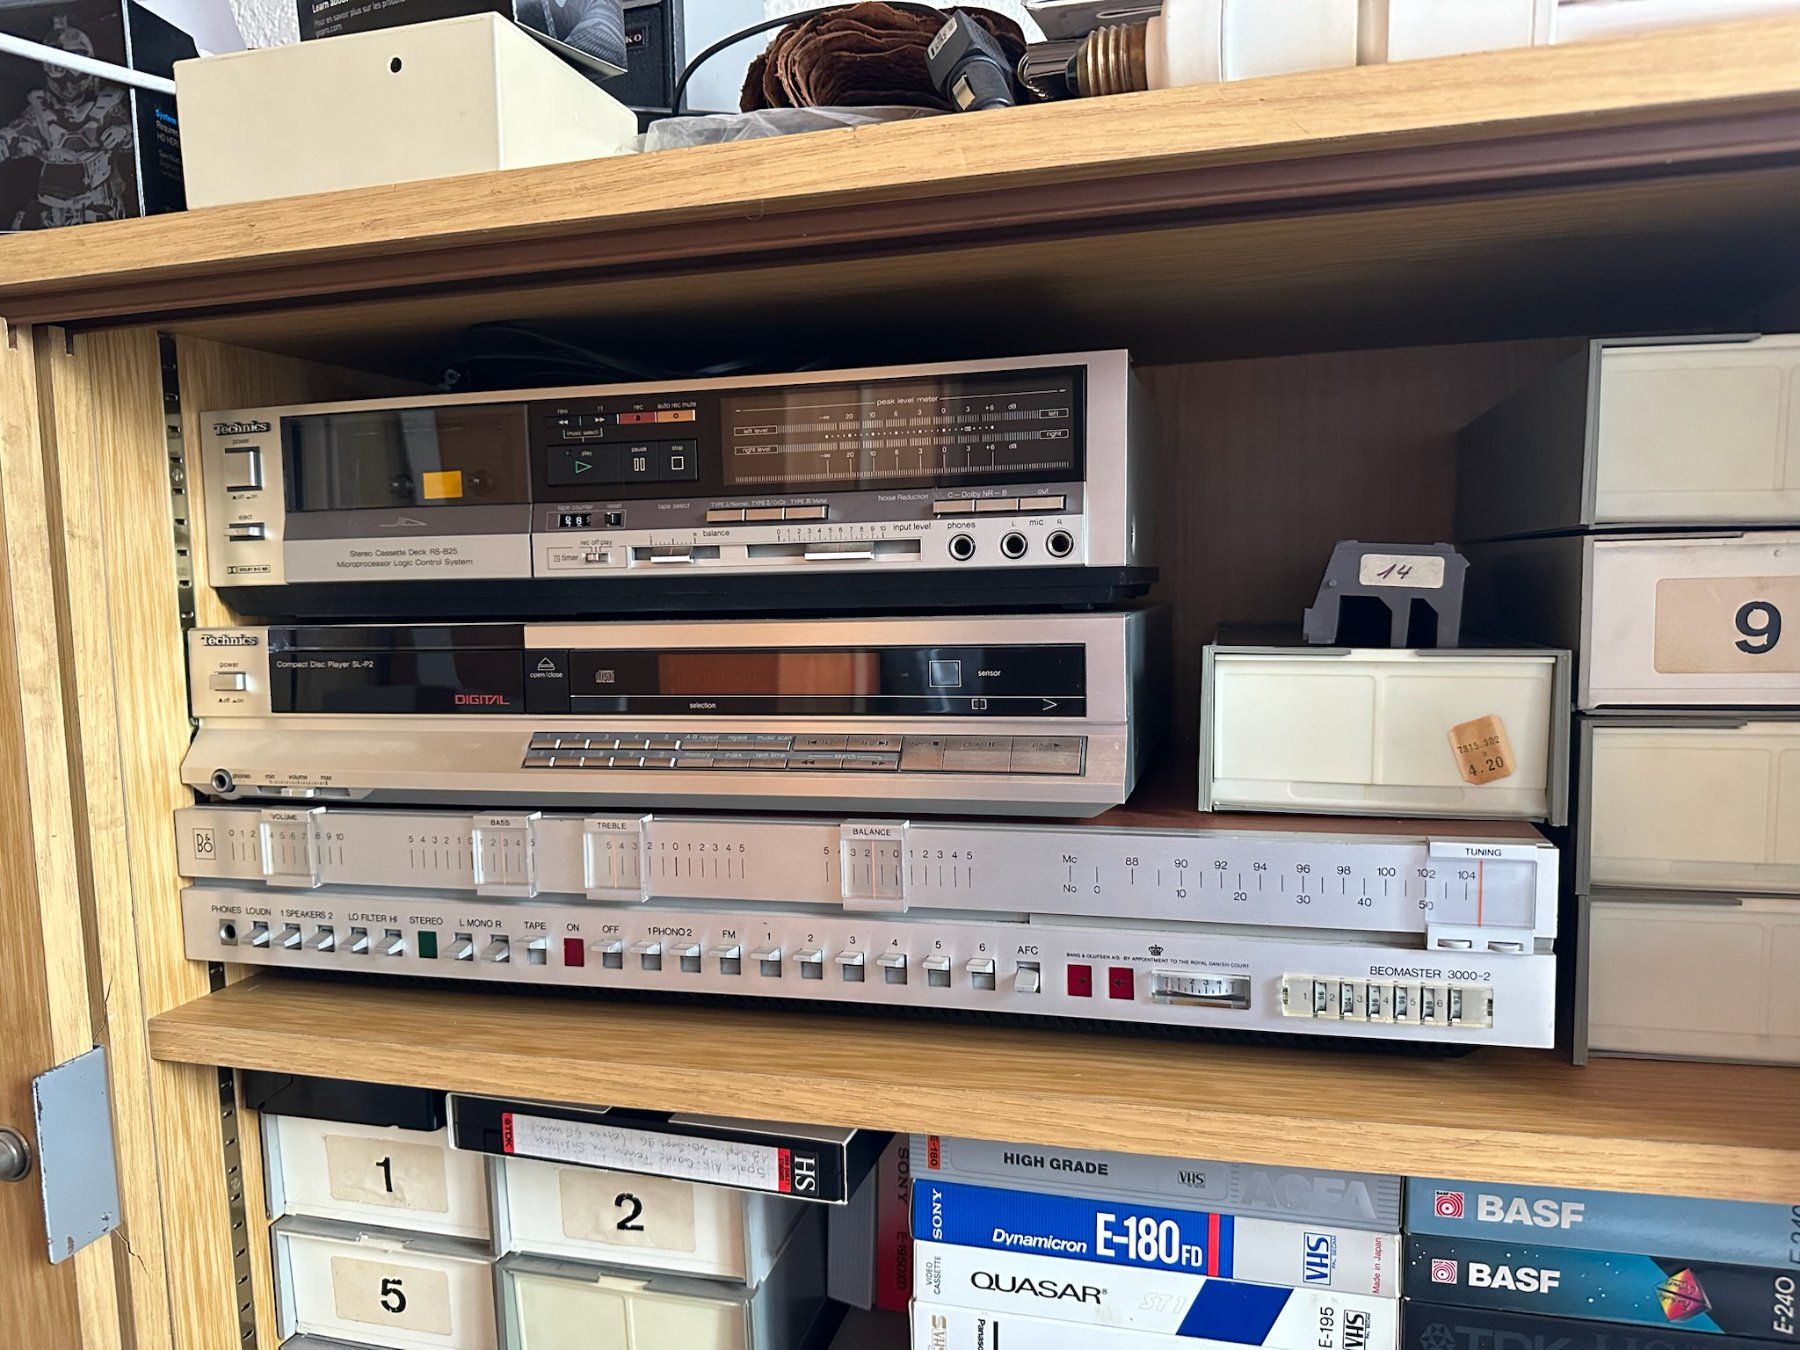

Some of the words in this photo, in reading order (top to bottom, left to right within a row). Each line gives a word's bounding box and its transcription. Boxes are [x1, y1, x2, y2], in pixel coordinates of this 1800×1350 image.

[312, 2, 329, 13] Learn
[350, 8, 362, 18] plus
[362, 5, 372, 13] sur
[315, 24, 342, 38] gopro.com
[876, 398, 895, 406] peak
[916, 395, 938, 403] meter
[213, 421, 271, 436] Technics
[961, 490, 981, 499] Dolby
[893, 523, 912, 532] input
[913, 522, 932, 531] level
[947, 520, 976, 529] phones
[702, 529, 730, 537] balance
[375, 549, 406, 557] Cassette
[408, 548, 427, 556] Deck
[429, 547, 458, 555] RS-B25
[337, 560, 391, 569] Microprocessor
[393, 559, 413, 568] Logic
[414, 558, 442, 566] Control
[444, 558, 473, 567] System
[1376, 563, 1412, 580] 14
[1735, 600, 1782, 655] 9
[202, 634, 258, 647] Technics
[219, 661, 239, 669] power
[276, 660, 308, 670] Compact
[310, 660, 325, 668] Disc
[327, 660, 350, 670] Player
[352, 660, 374, 668] SL-P2
[529, 671, 563, 680] open/close
[977, 669, 1001, 677] sensor
[454, 694, 510, 705] DIGITAL
[689, 701, 717, 709] selection
[1469, 756, 1504, 776] 4.20
[271, 813, 298, 821] VOLUME
[490, 819, 511, 827] BASS
[597, 822, 627, 830] TREBLE
[852, 828, 891, 836] BALANCE
[1465, 848, 1502, 857] TUNING
[1062, 855, 1077, 864] Mc
[1125, 857, 1139, 867] 88
[1174, 859, 1188, 868] 90
[1214, 860, 1228, 870] 92
[1253, 862, 1267, 872] 94
[1296, 864, 1311, 874] 96
[1336, 866, 1351, 876] 98
[1377, 867, 1396, 877] 100
[1417, 869, 1436, 879] 102
[1457, 870, 1476, 880] 104
[1093, 885, 1101, 894] 0
[1176, 889, 1186, 899] 10
[1233, 892, 1247, 902] 20
[1296, 895, 1311, 905] 30
[1357, 897, 1372, 907] 40
[1418, 900, 1434, 911] 50
[211, 905, 242, 914] PHONES
[245, 906, 271, 916] LOUDN
[286, 909, 326, 919] SPEAKERS
[349, 913, 359, 921] LO
[361, 913, 387, 923] FILTER
[389, 915, 398, 923] HI
[409, 916, 443, 926] STEREO
[466, 919, 493, 928] MONO
[524, 921, 546, 931] TAPE
[566, 923, 580, 932] ON
[602, 925, 620, 934] OFF
[652, 927, 684, 937] PHONO
[722, 929, 736, 939] FM
[1017, 945, 1038, 955] AFC
[1131, 956, 1168, 964] APPOINTMENT
[1370, 966, 1441, 978] BEOMASTER
[1447, 969, 1491, 981] 3000-2
[930, 1135, 938, 1166] E-180
[1003, 1152, 1045, 1168] HIGH
[1049, 1159, 1109, 1176] GRADE
[375, 1156, 395, 1193] 1
[795, 1155, 815, 1190] HS
[897, 1146, 909, 1204] SONY
[1179, 1171, 1205, 1185] VHS
[1241, 1169, 1377, 1220] AGFA
[614, 1192, 645, 1232] 2
[932, 1188, 942, 1239] SONY
[1477, 1194, 1585, 1229] BASF
[992, 1229, 1088, 1254] Dynamicron
[1095, 1213, 1180, 1266] E-180
[1181, 1243, 1203, 1267] FD
[1374, 1238, 1382, 1260] Japan
[1305, 1236, 1329, 1280] VHS
[933, 1256, 941, 1294] CASSETTE
[1468, 1262, 1561, 1294] BASF
[1373, 1273, 1381, 1294] Made
[380, 1277, 407, 1313] 5
[1773, 1276, 1795, 1335] E-240
[1319, 1307, 1334, 1348] E-195
[1345, 1312, 1364, 1348] VHS
